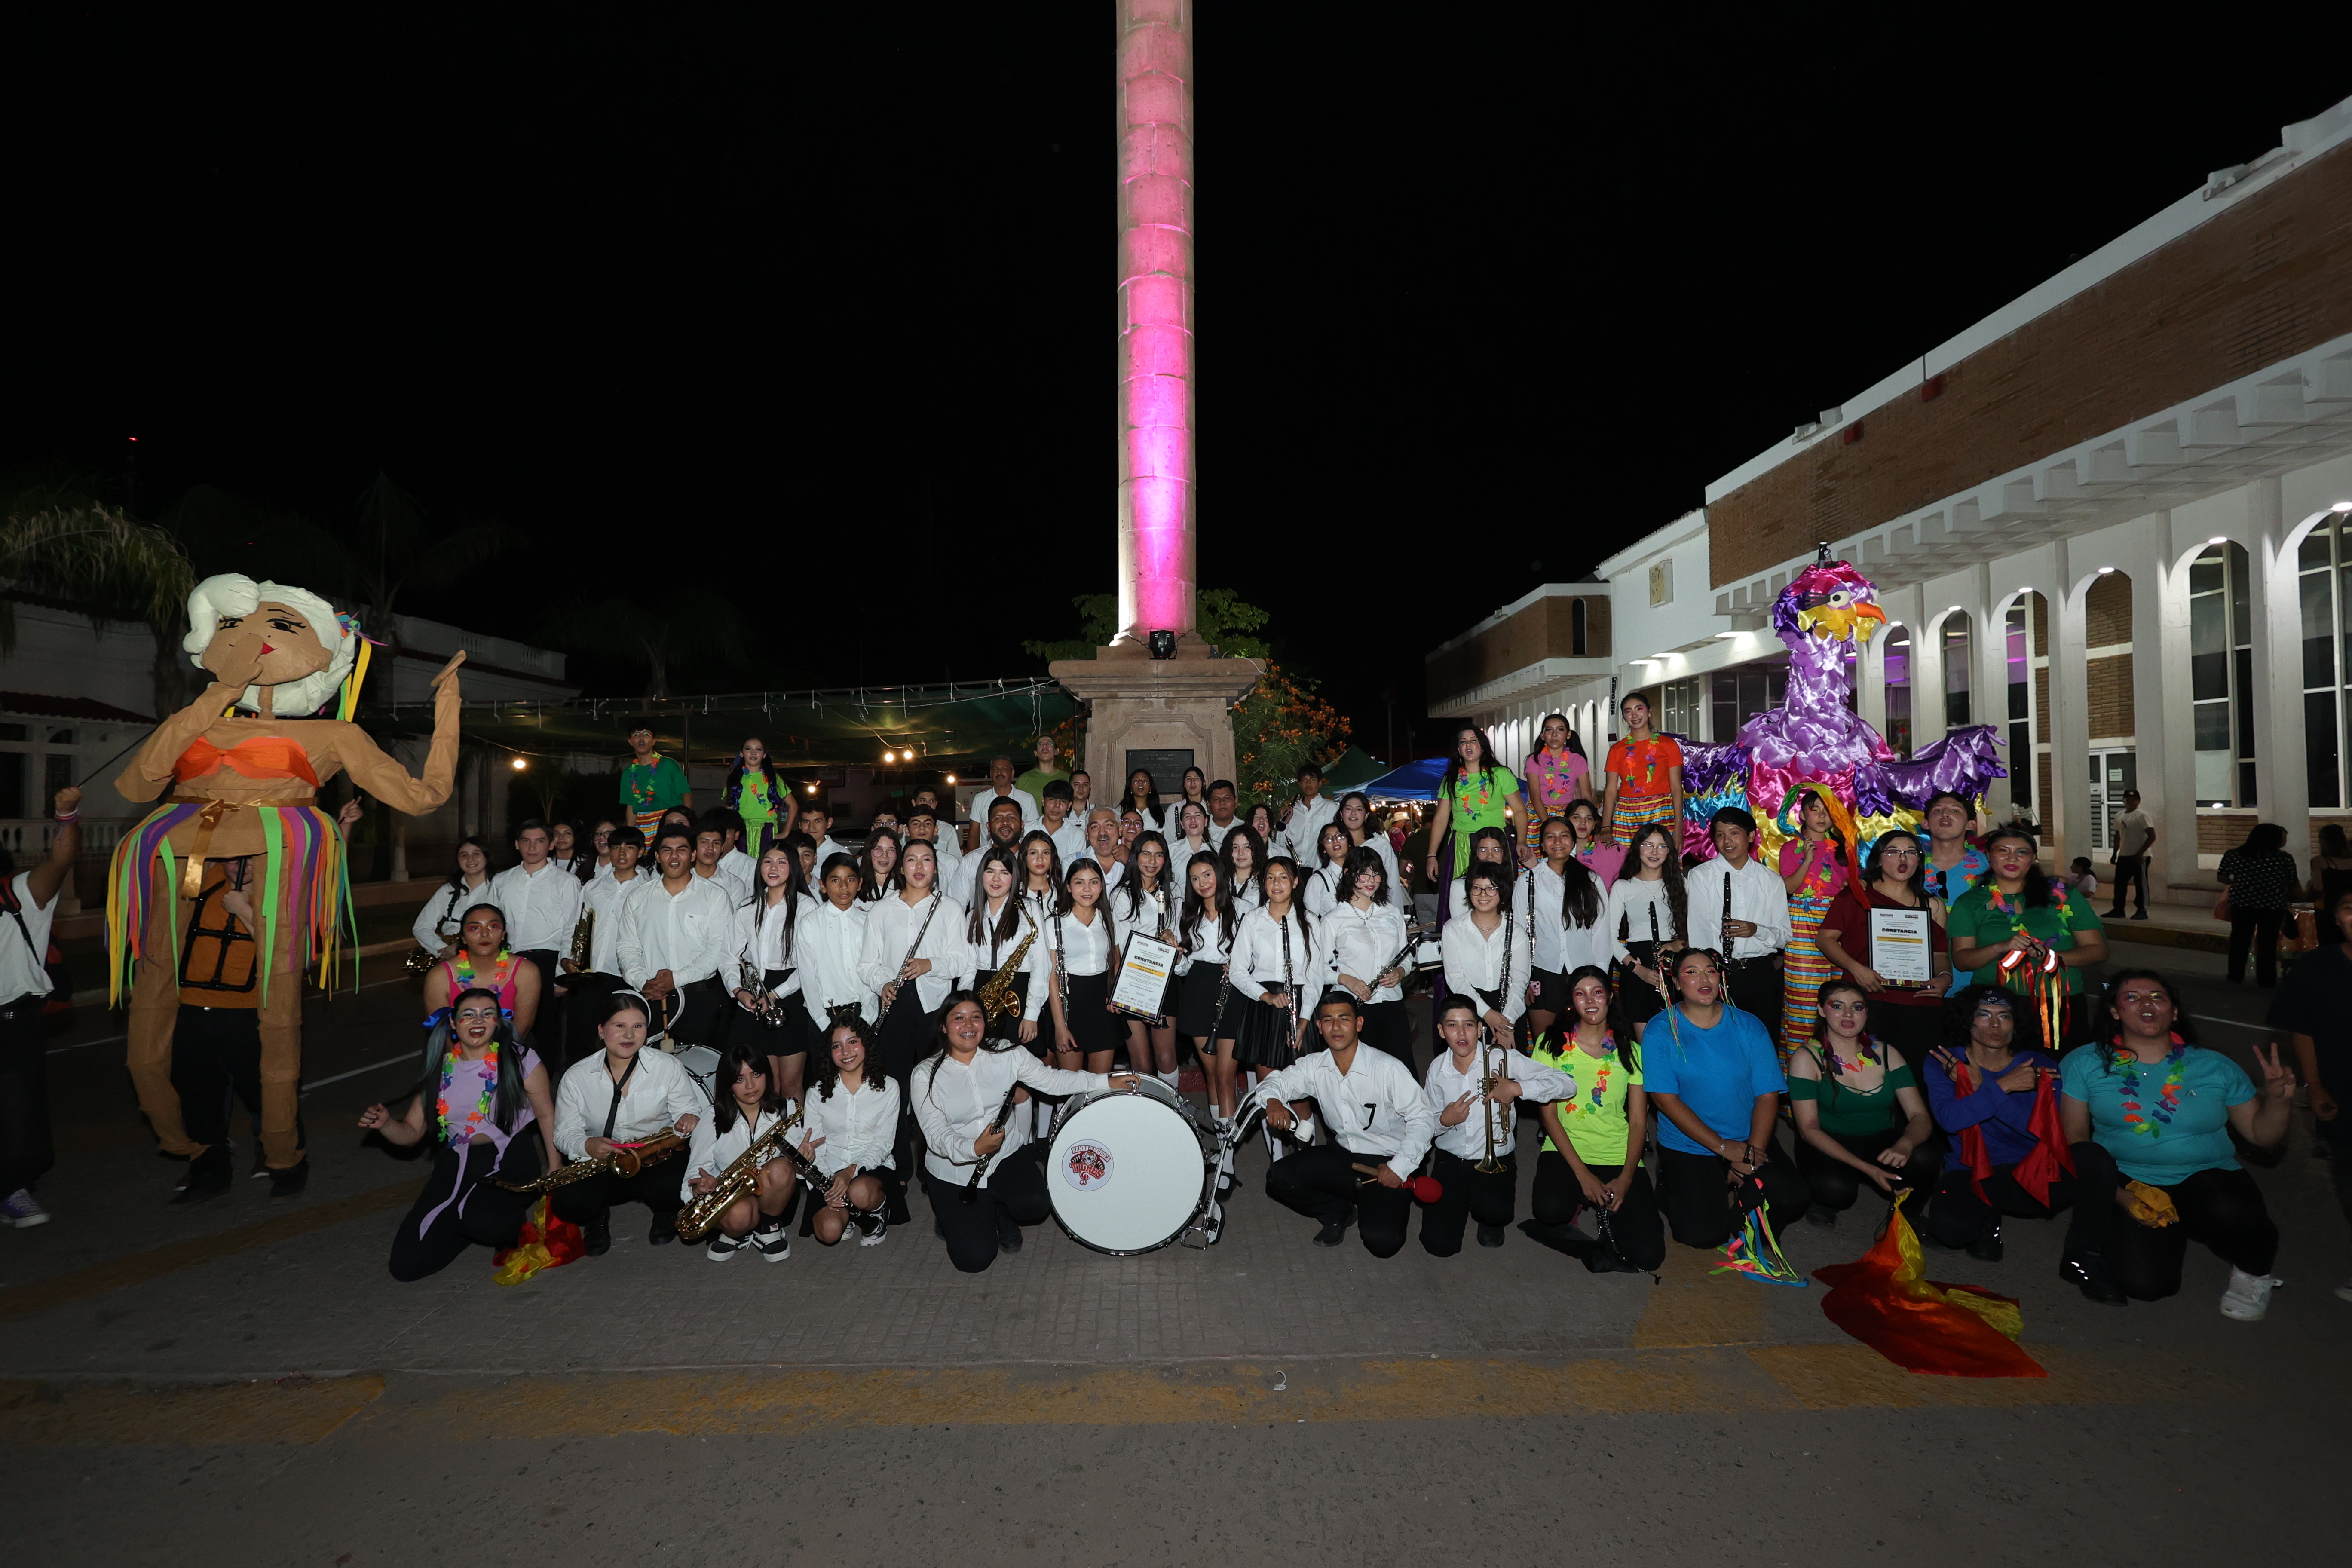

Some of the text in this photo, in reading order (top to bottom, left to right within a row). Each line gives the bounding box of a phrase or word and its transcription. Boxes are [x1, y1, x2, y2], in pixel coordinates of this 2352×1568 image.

[1134, 955, 1164, 968] CONSTANCIA
[1093, 1147, 1111, 1162] MÚSICA
[1069, 1162, 1105, 1179] TIGRES
